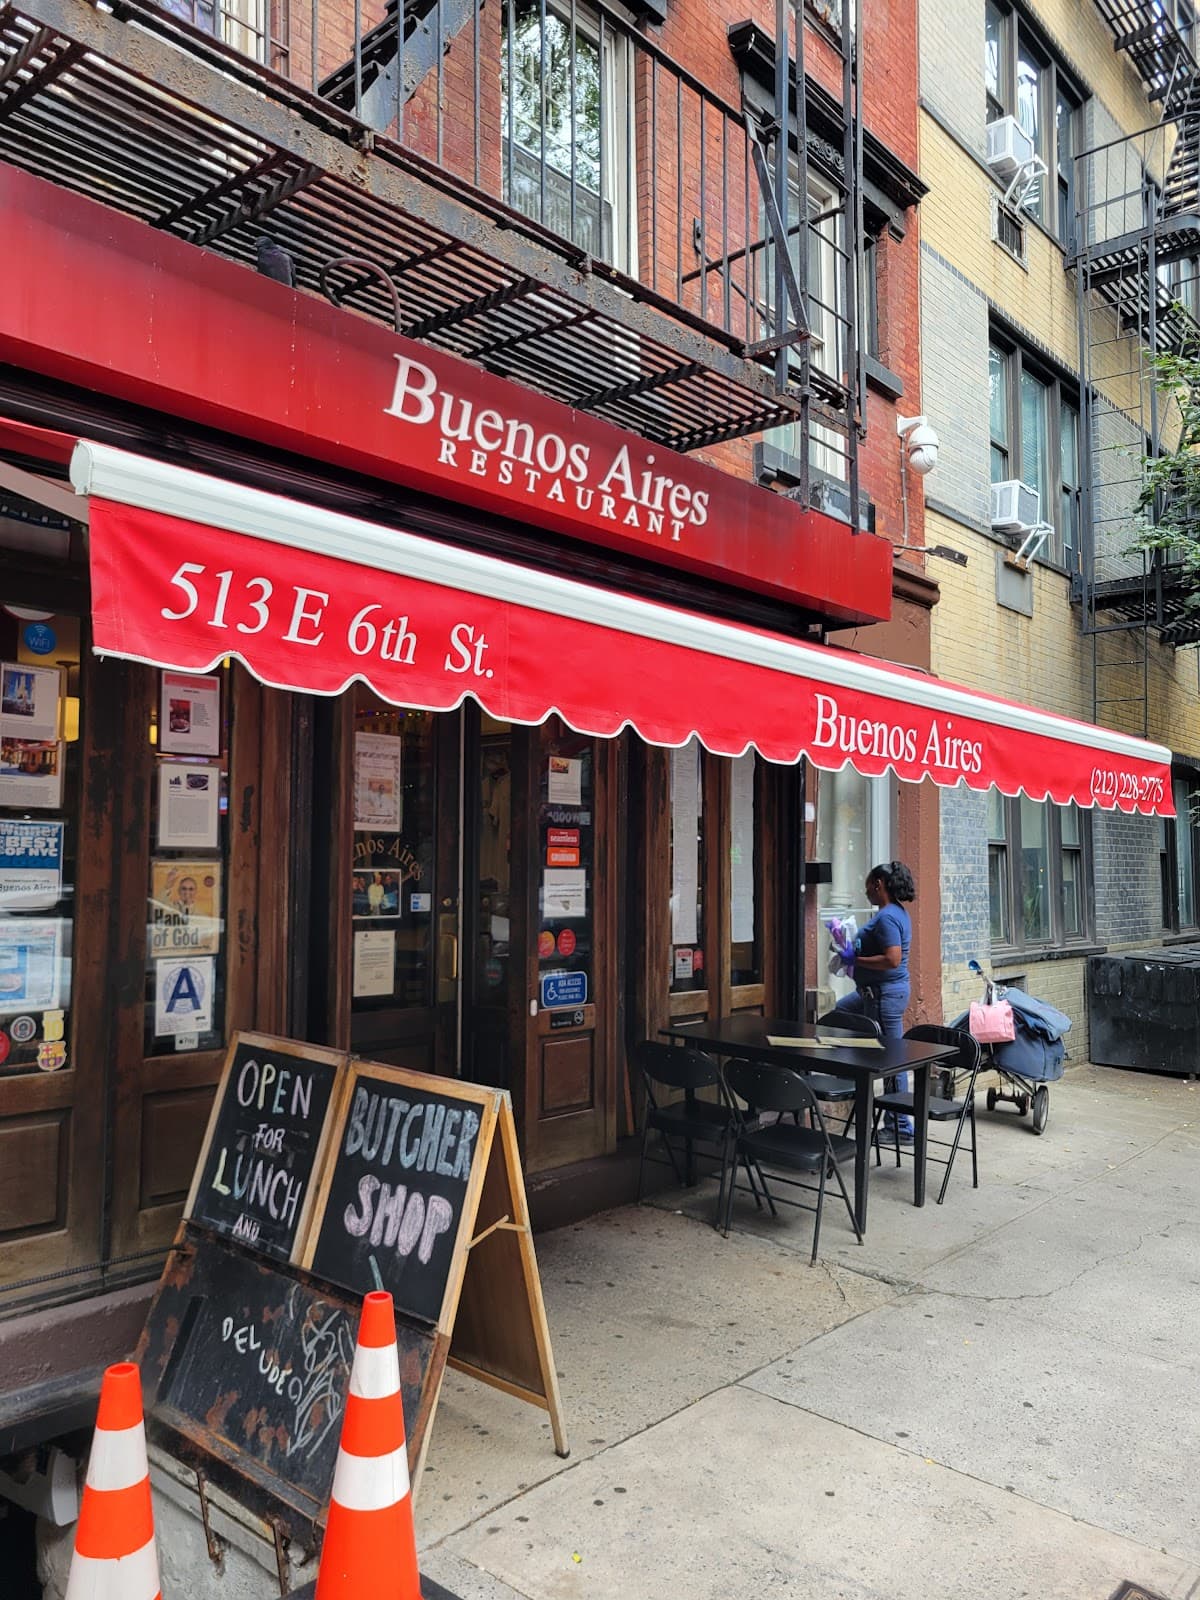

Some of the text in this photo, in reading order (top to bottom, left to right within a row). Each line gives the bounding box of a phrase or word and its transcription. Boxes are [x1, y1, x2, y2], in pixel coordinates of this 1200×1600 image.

[383, 353, 709, 526] Buenos Aires
[438, 438, 684, 541] RESTAURANT
[161, 562, 495, 679] 513 E 6th St.
[811, 693, 982, 773] Buenos Aires
[1090, 767, 1164, 803] (212) 228-2775
[5, 835, 58, 848] BEST
[5, 847, 58, 857] OF NYC
[353, 838, 385, 862] nos
[153, 927, 199, 947] of God
[155, 907, 189, 926] Hand
[165, 967, 201, 1013] A
[237, 1059, 313, 1120] OPEN
[255, 1122, 286, 1153] FOR
[344, 1086, 480, 1181] BUTCHER
[212, 1147, 302, 1230] LUNCH
[232, 1212, 260, 1242] AND
[344, 1174, 453, 1265] SHOP
